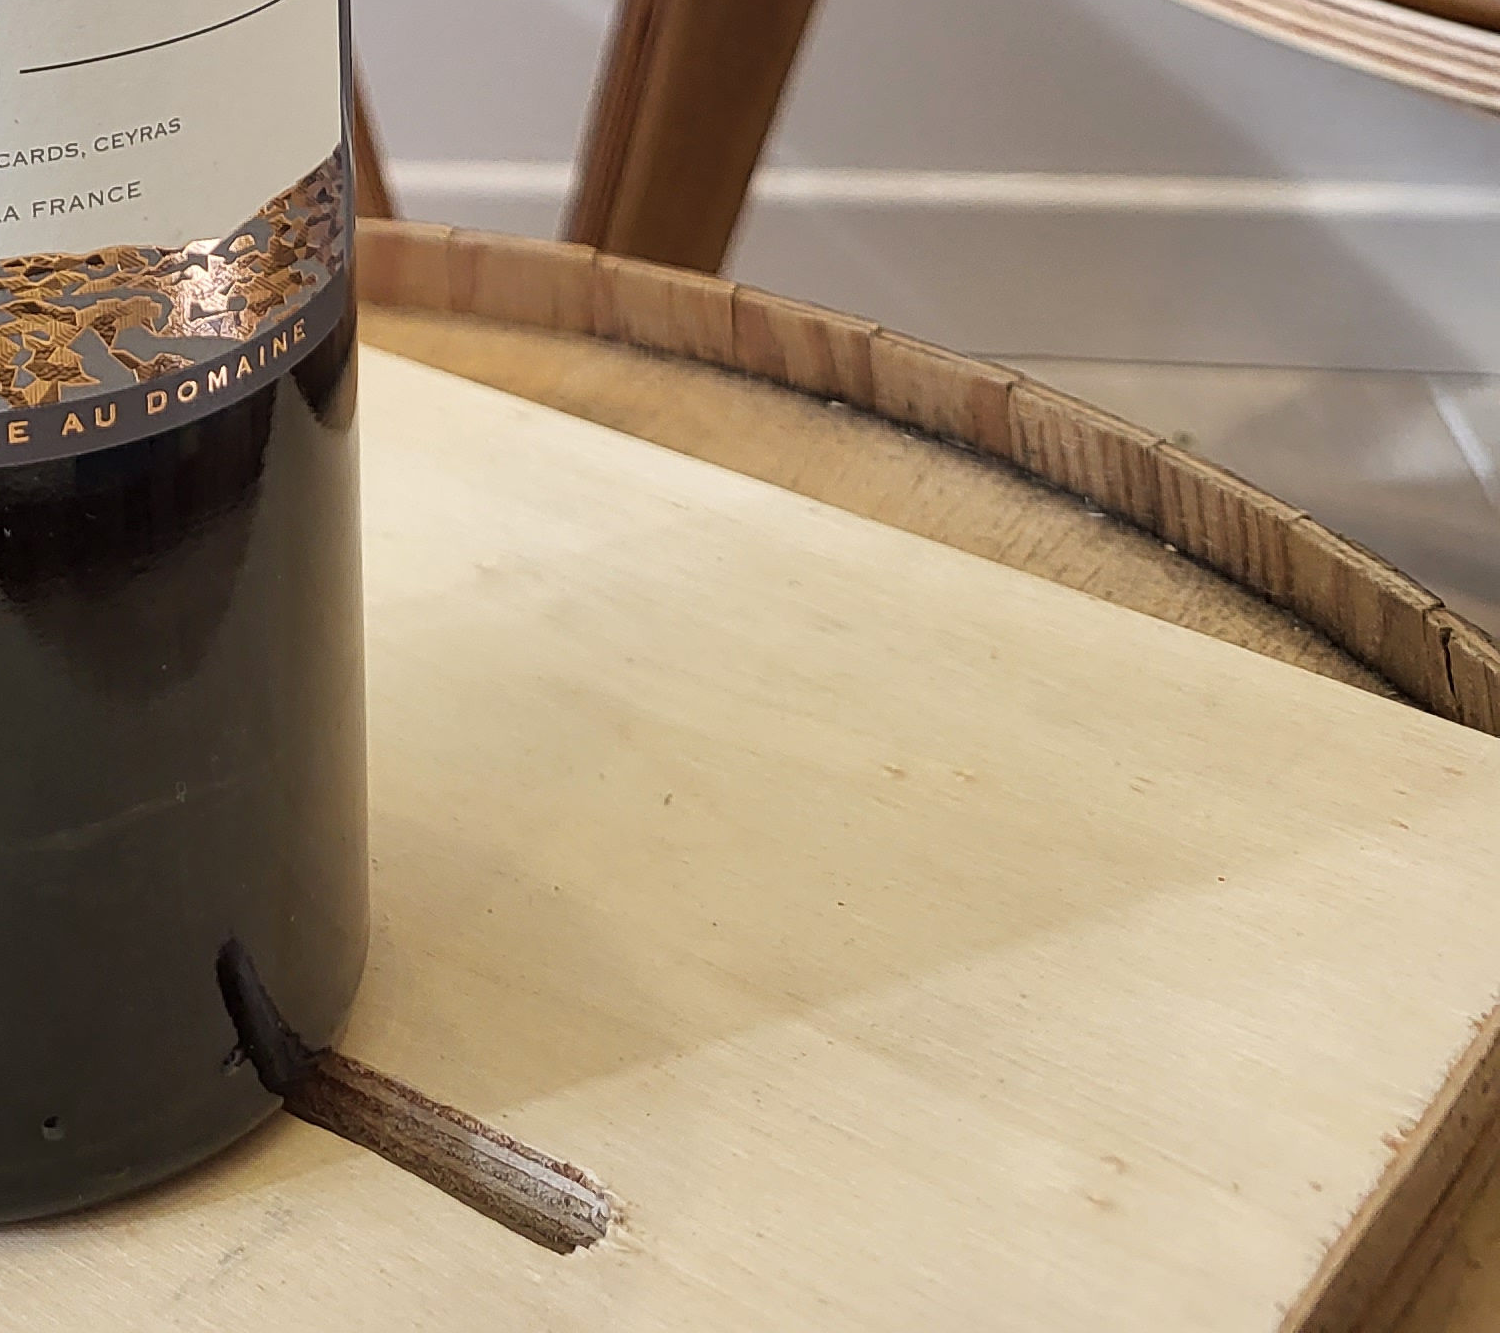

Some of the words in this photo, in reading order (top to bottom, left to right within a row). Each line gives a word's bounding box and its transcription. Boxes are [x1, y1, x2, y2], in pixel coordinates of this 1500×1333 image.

[93, 116, 182, 154] CEYRAS
[32, 180, 142, 218] FRANCE
[61, 405, 117, 439] AU
[146, 317, 308, 412] DOMAINE
